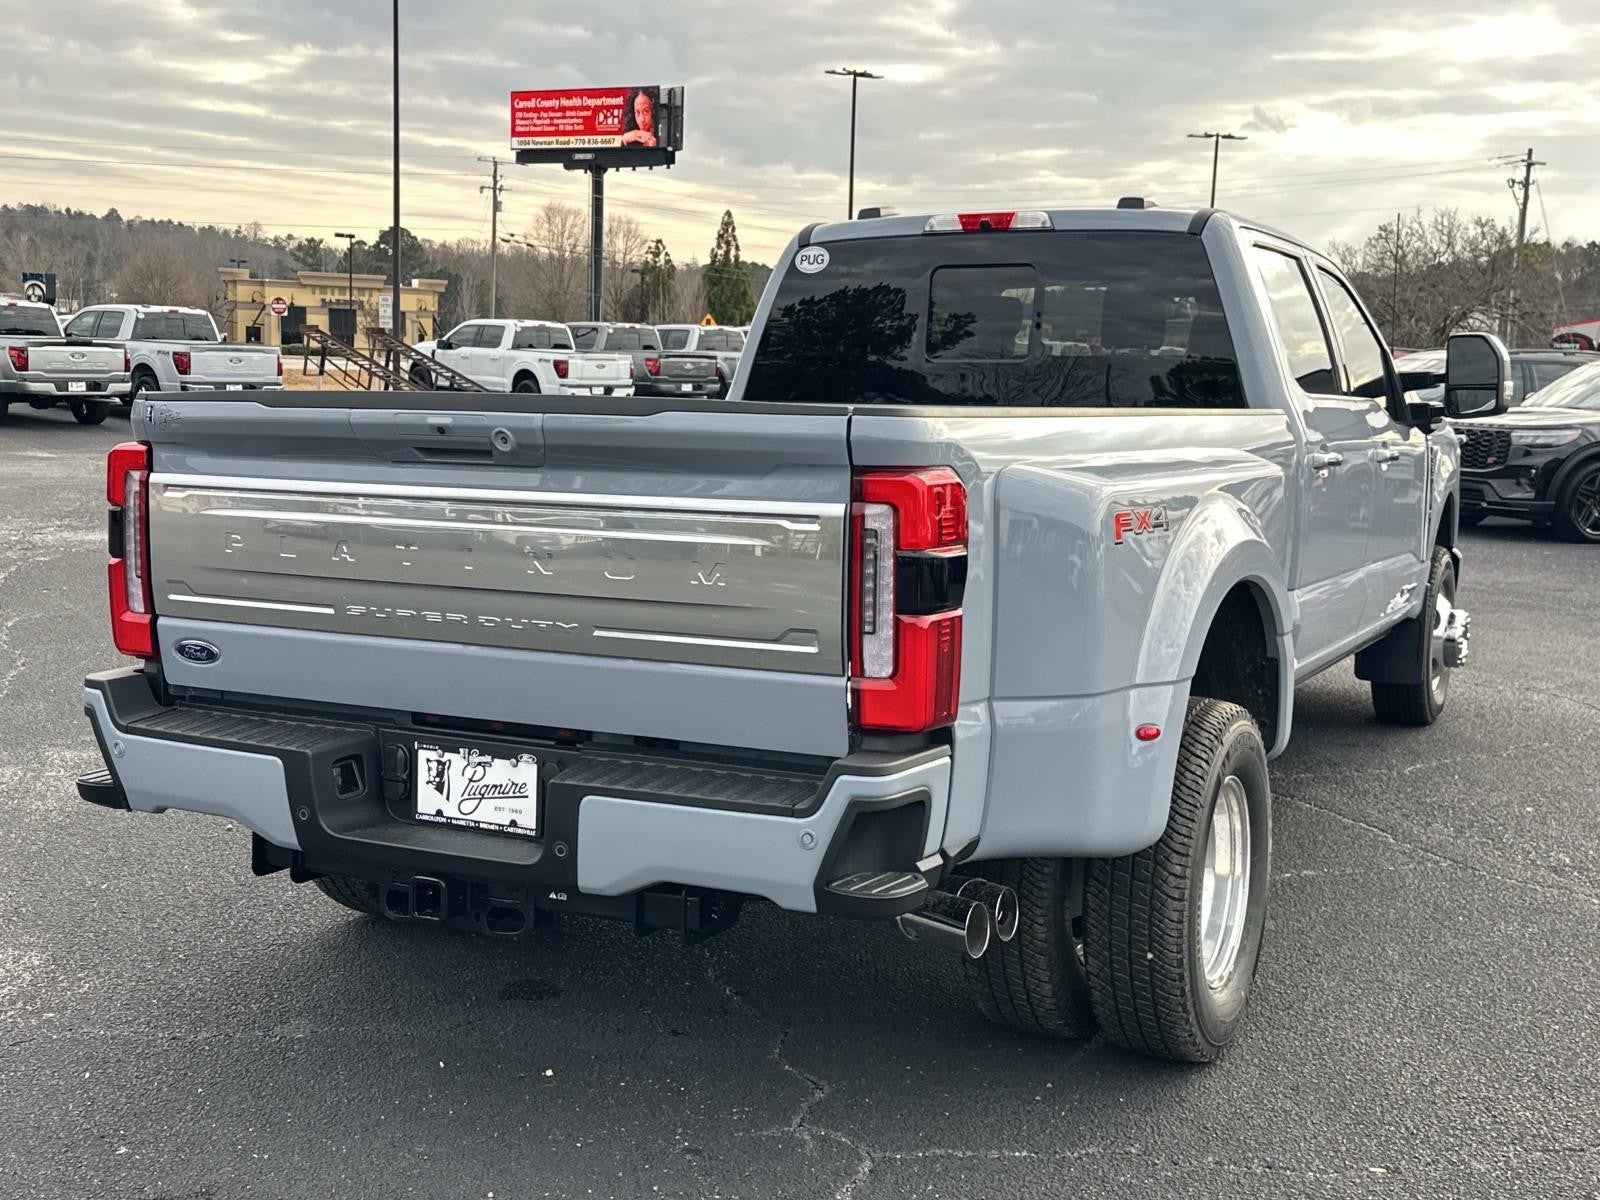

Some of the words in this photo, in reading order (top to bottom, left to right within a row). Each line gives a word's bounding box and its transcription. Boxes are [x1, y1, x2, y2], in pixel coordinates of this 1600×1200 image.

[514, 98, 535, 109] Carroll
[536, 98, 559, 110] County
[560, 96, 582, 107] Health
[583, 96, 624, 108] Department
[800, 253, 825, 266] PUG
[1113, 504, 1170, 545] FX4
[225, 531, 726, 586] PLATINUM
[346, 605, 469, 625] SUPER
[477, 614, 579, 632] DUTY
[458, 762, 529, 815] Pugmire
